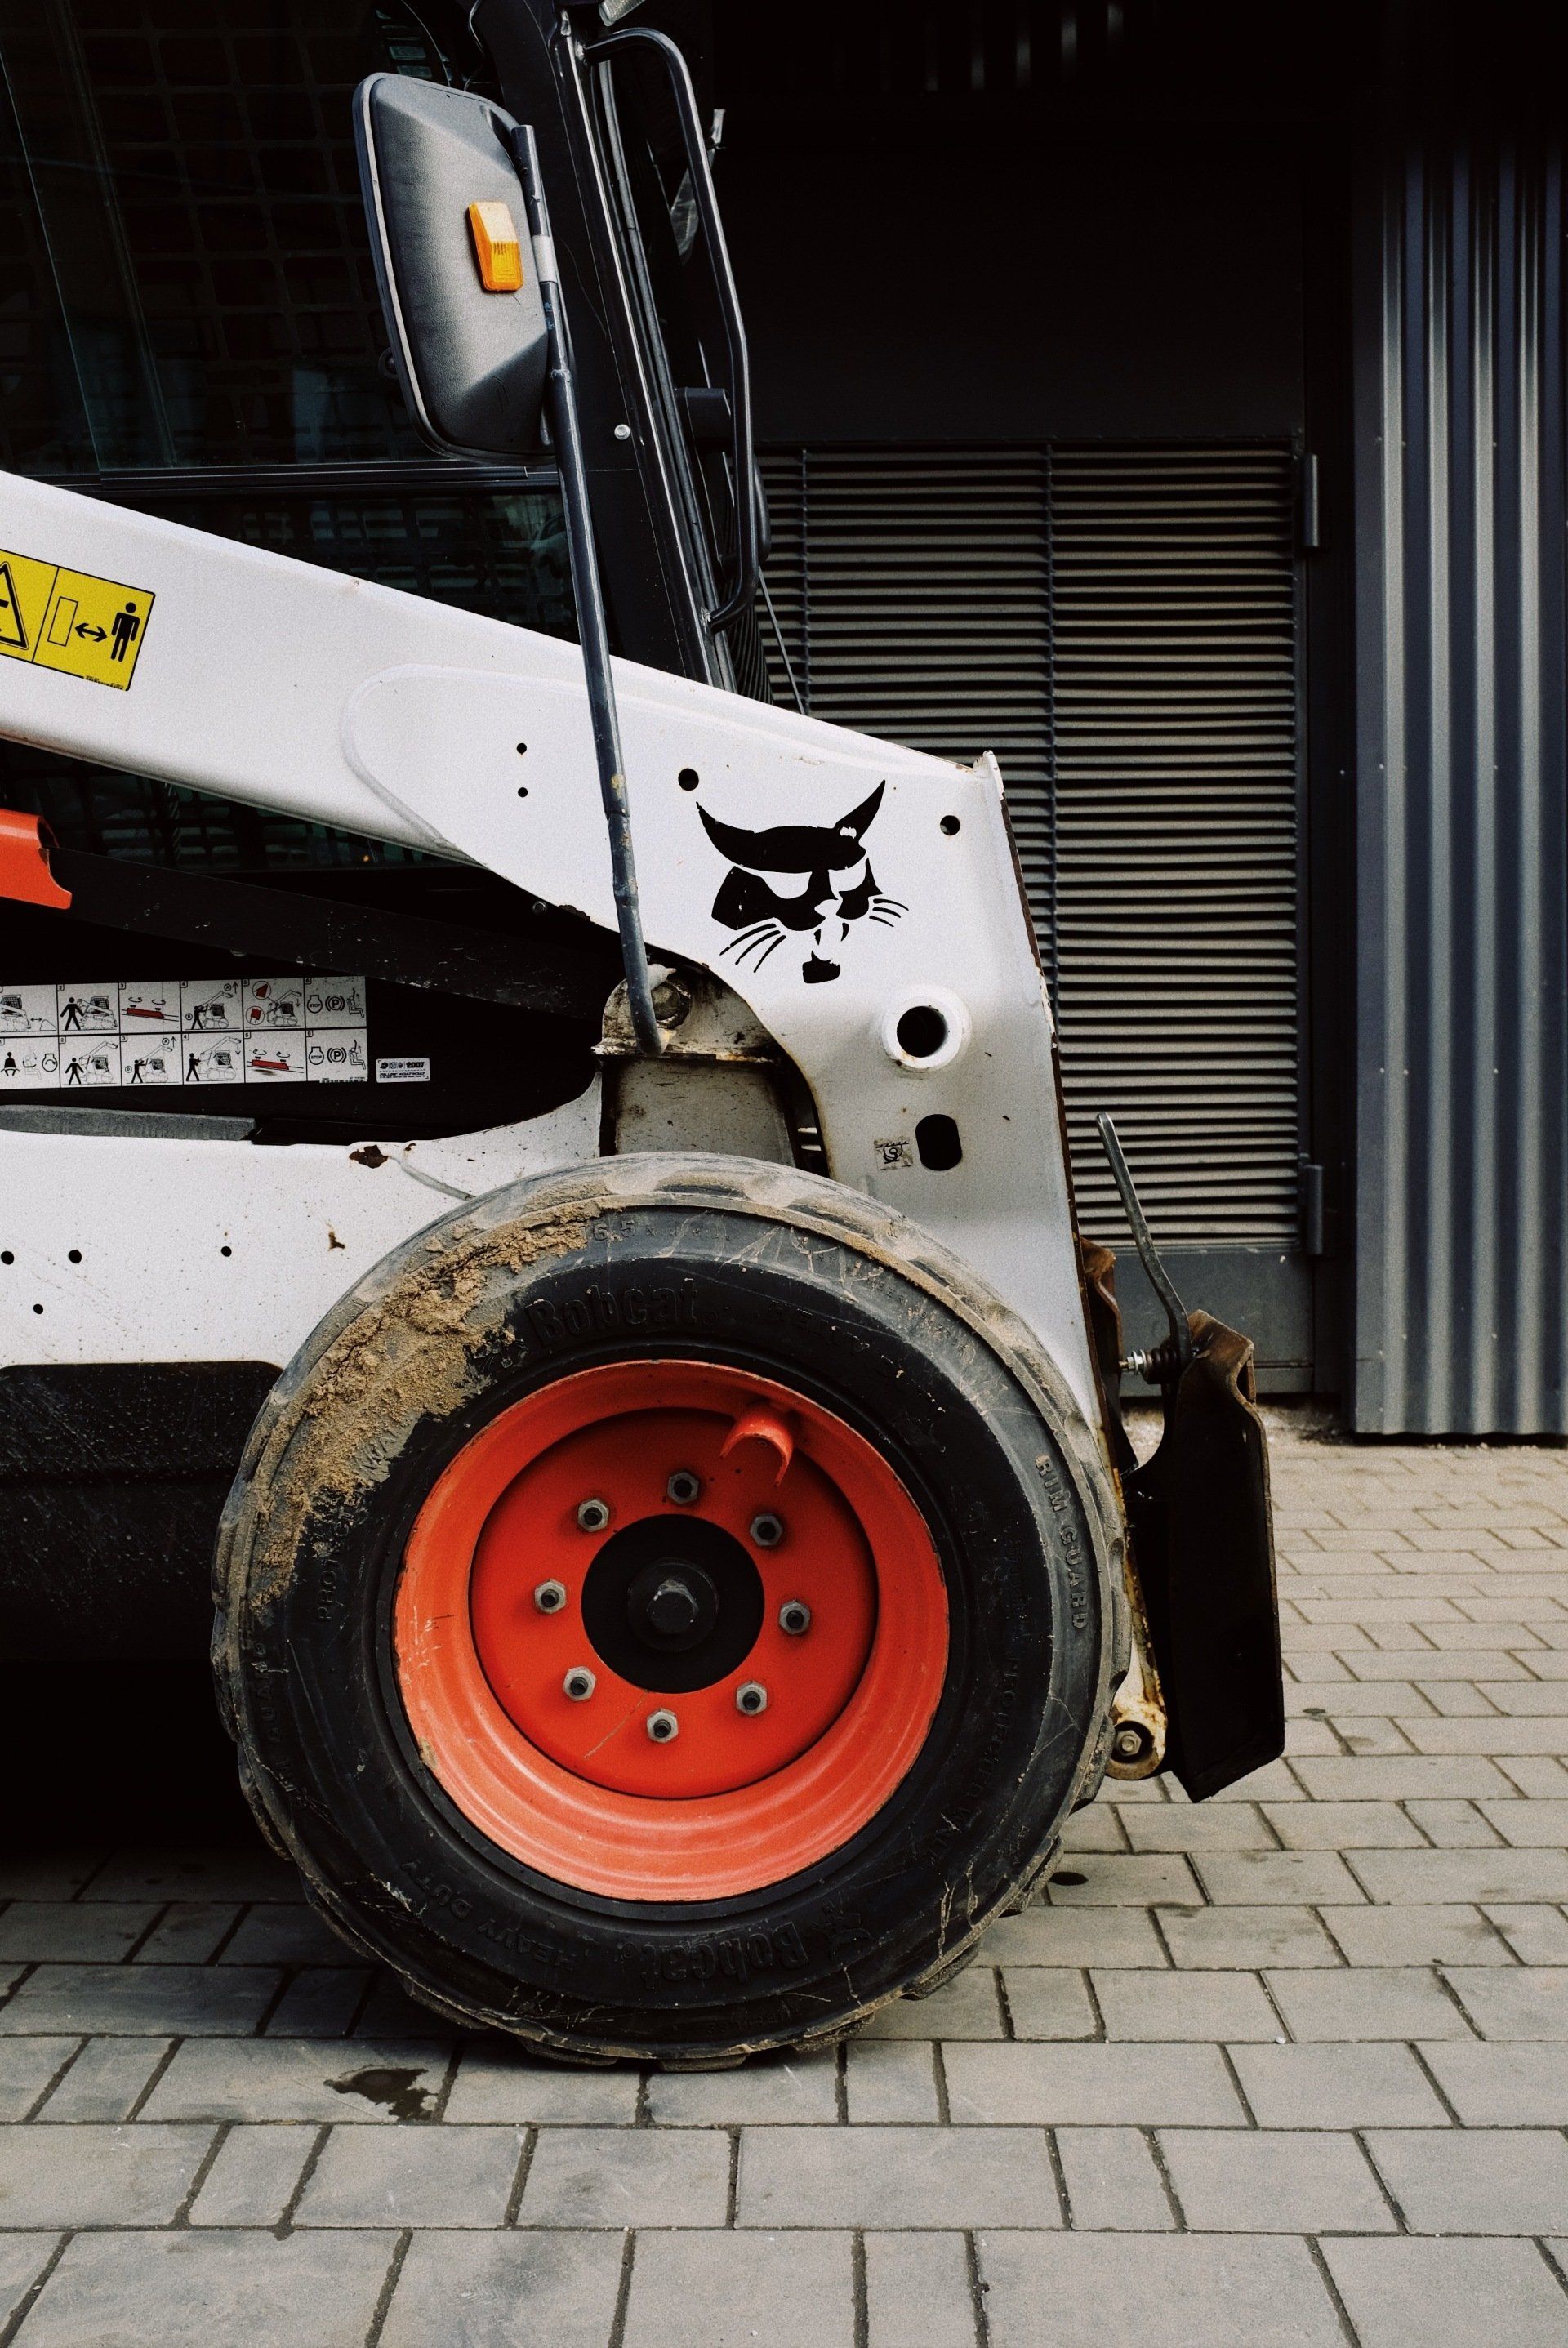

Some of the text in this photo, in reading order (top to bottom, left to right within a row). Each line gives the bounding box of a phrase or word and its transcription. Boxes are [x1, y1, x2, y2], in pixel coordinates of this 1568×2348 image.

[332, 999, 340, 1009] P
[333, 1050, 341, 1060] P
[524, 1276, 699, 1348] Bobcat
[1034, 1454, 1089, 1630] RIM GUARD
[401, 1859, 577, 1972] HEAVY DUTY
[639, 1920, 810, 1993] Bobcat
